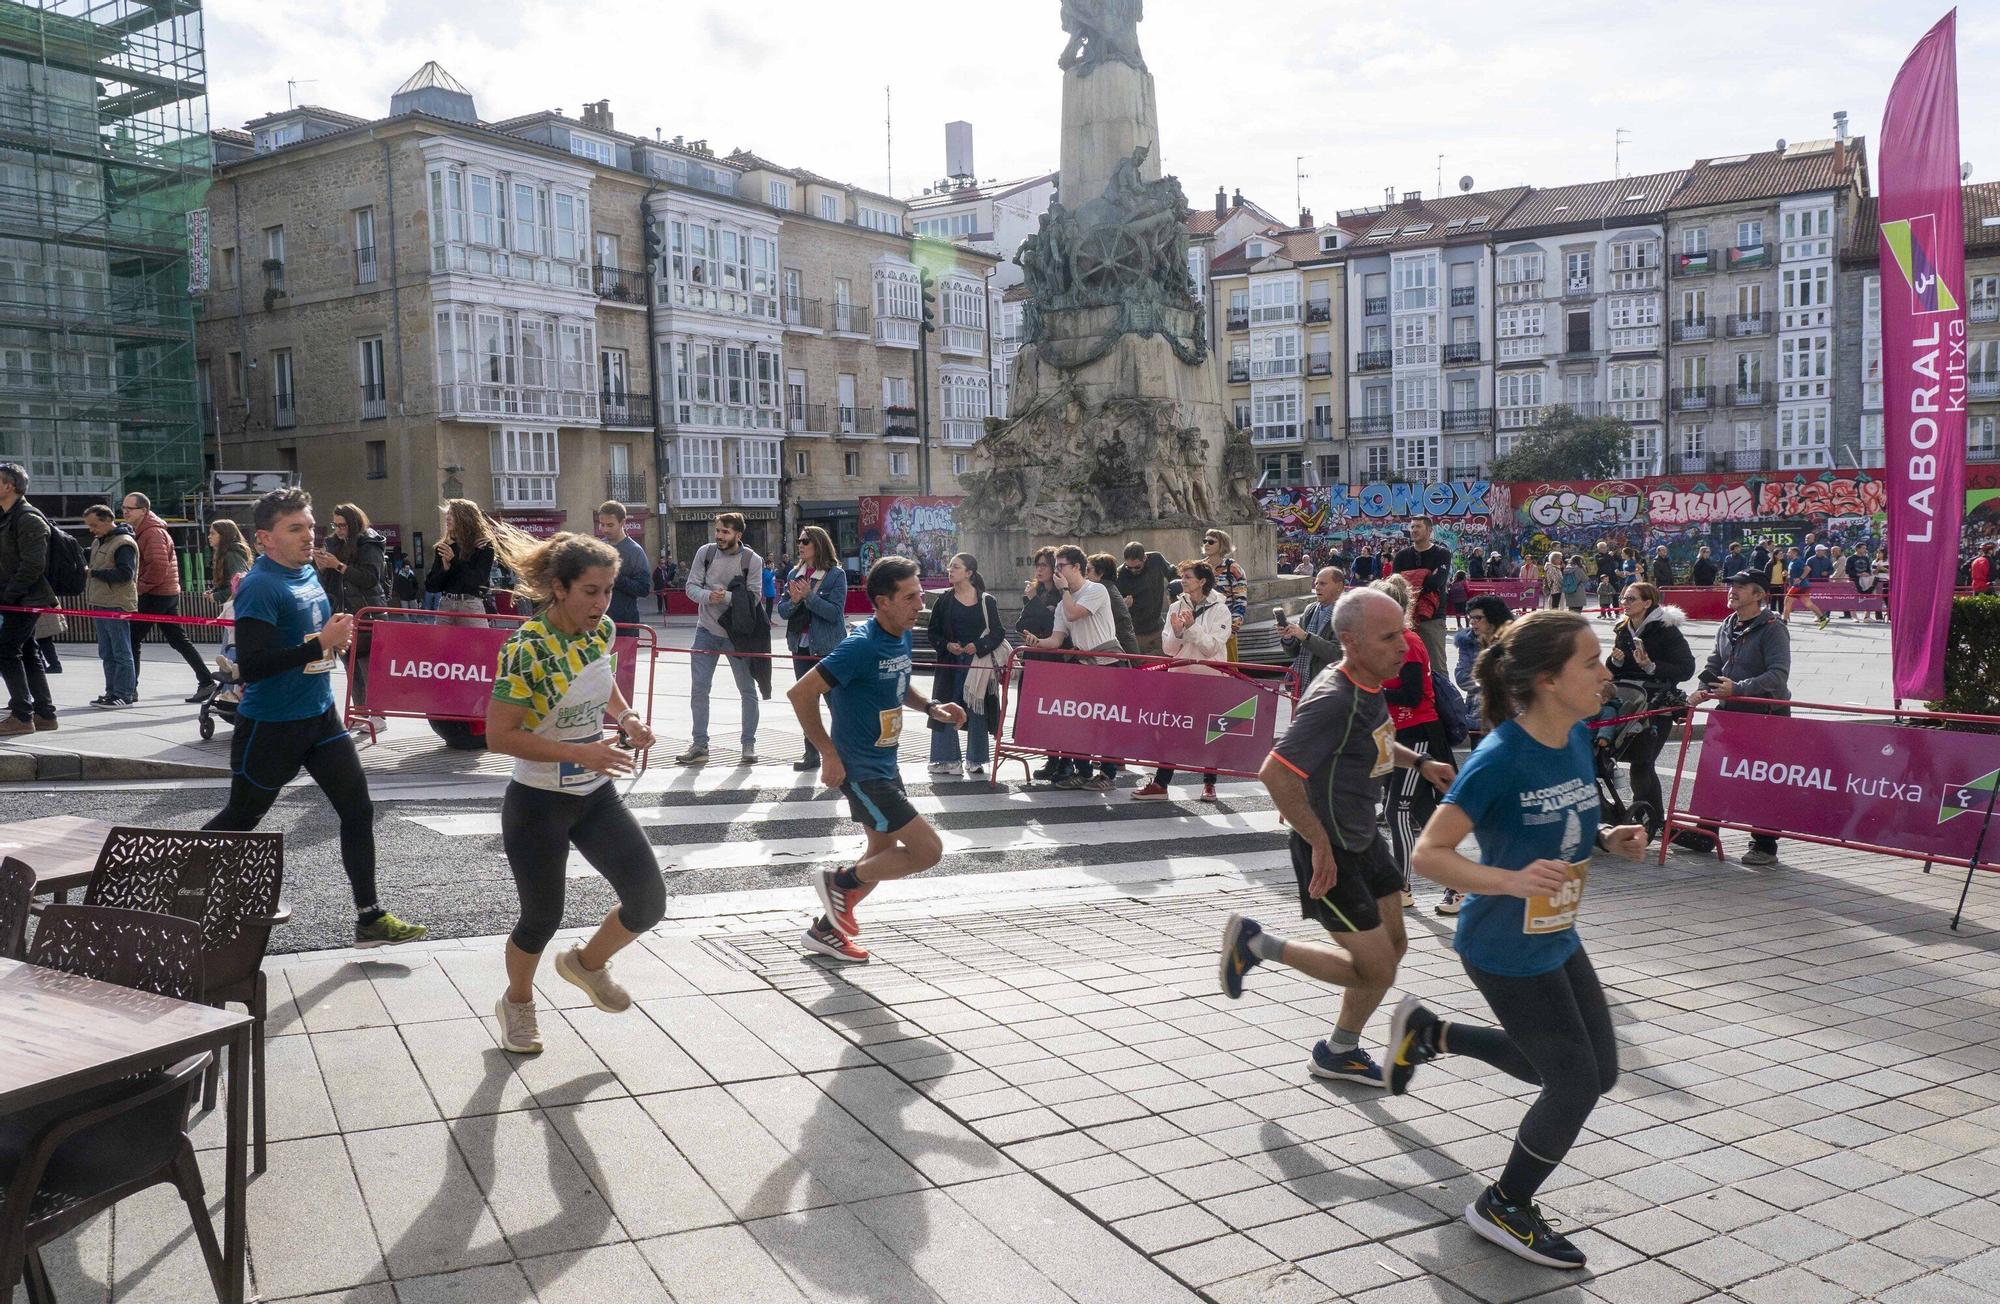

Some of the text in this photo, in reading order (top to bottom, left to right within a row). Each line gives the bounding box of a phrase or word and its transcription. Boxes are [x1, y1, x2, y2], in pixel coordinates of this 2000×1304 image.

[1945, 319, 1966, 412] kutxa
[1907, 321, 1940, 543] LABORAL
[390, 659, 493, 683] LABORAL
[1037, 697, 1193, 729] LABORAL kutxa
[1720, 757, 1923, 803] LABORAL kutxa
